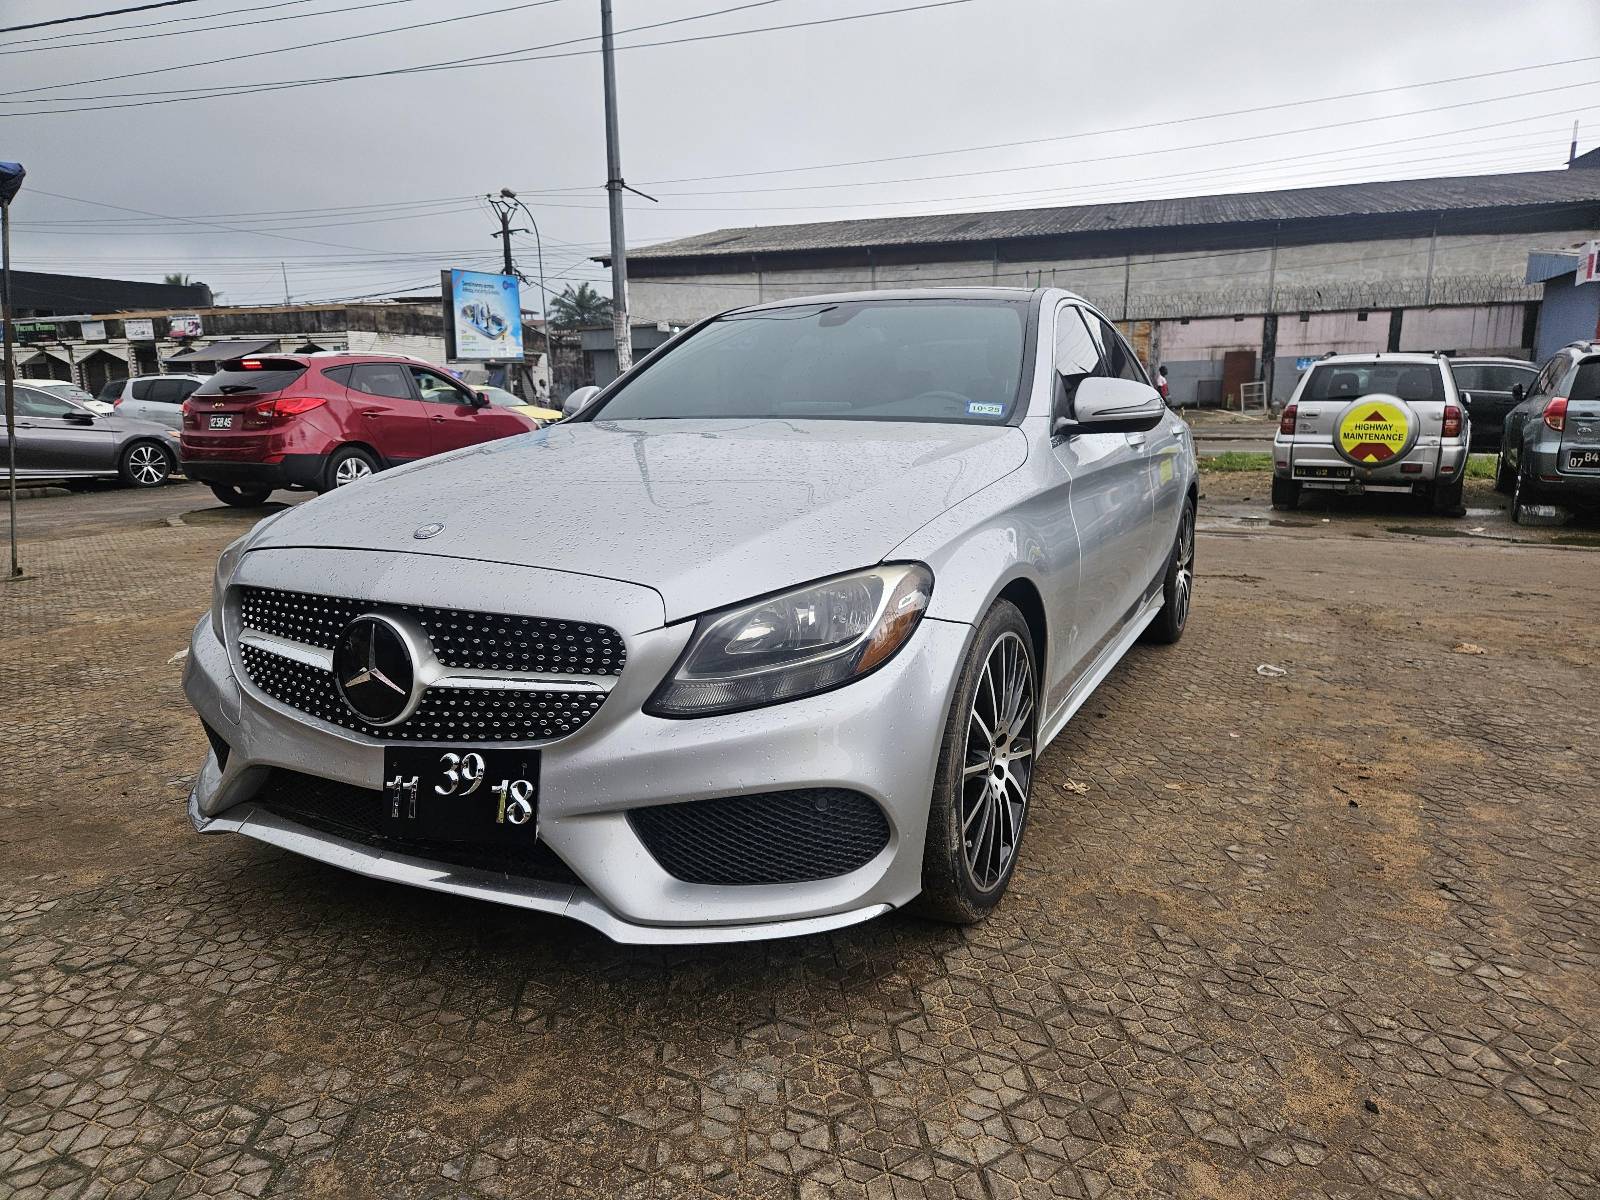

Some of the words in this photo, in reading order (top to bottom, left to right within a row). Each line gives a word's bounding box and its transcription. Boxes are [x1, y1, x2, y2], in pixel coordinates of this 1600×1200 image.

[1354, 423, 1394, 432] HIGHWAY
[1342, 432, 1404, 441] MAINTENANCE
[1570, 457, 1584, 467] 07
[1584, 452, 1600, 462] 84
[386, 775, 420, 819] 11
[434, 752, 486, 796] 39
[491, 779, 534, 825] 18
